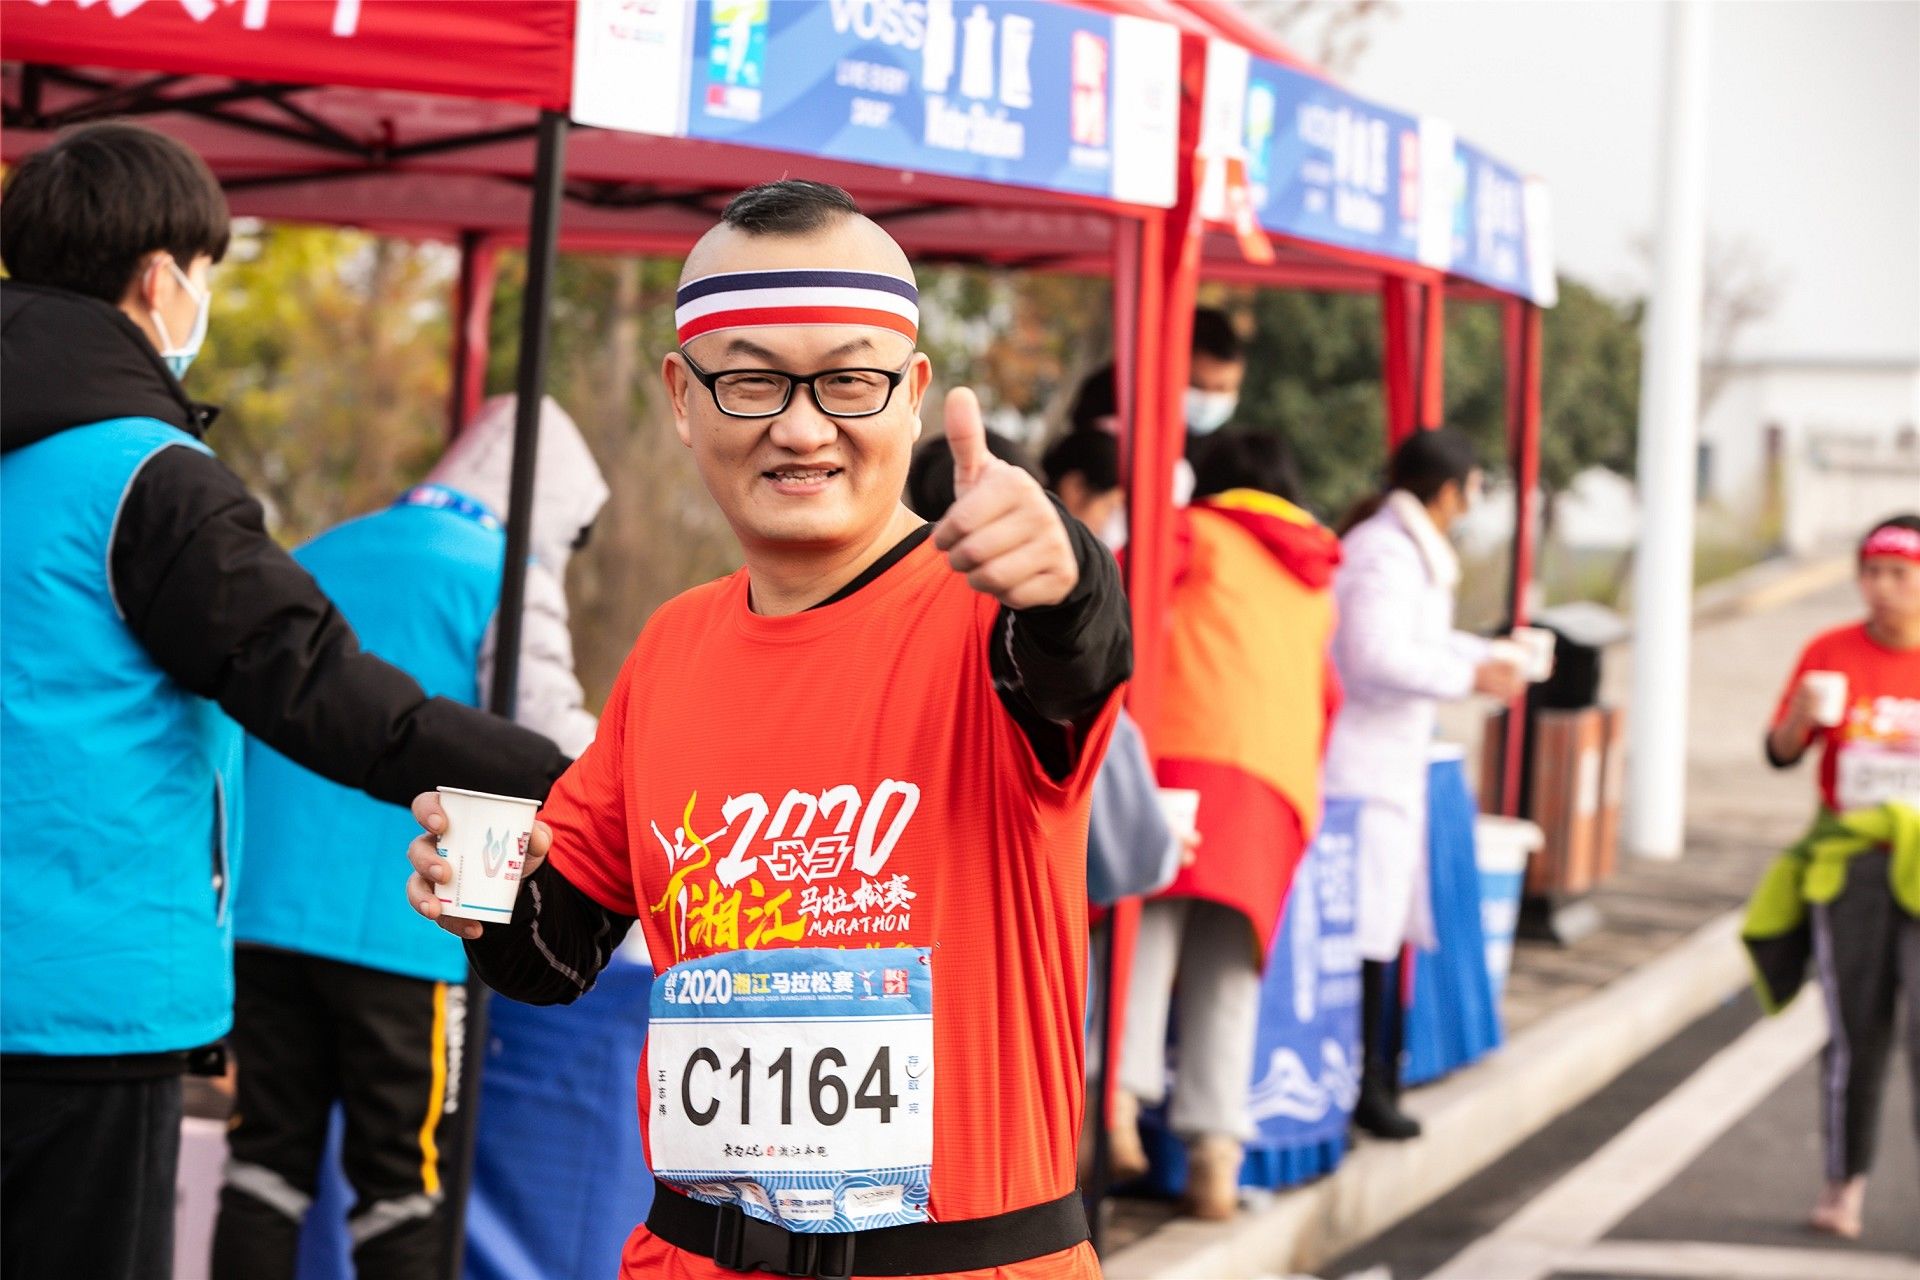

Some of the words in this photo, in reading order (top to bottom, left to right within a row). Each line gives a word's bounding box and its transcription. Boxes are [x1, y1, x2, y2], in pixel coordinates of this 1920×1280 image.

[715, 778, 921, 888] 2020
[686, 878, 807, 949] 湘江
[796, 873, 918, 918] 马拉松赛
[806, 913, 911, 938] MARATHON
[681, 1046, 898, 1127] C1164
